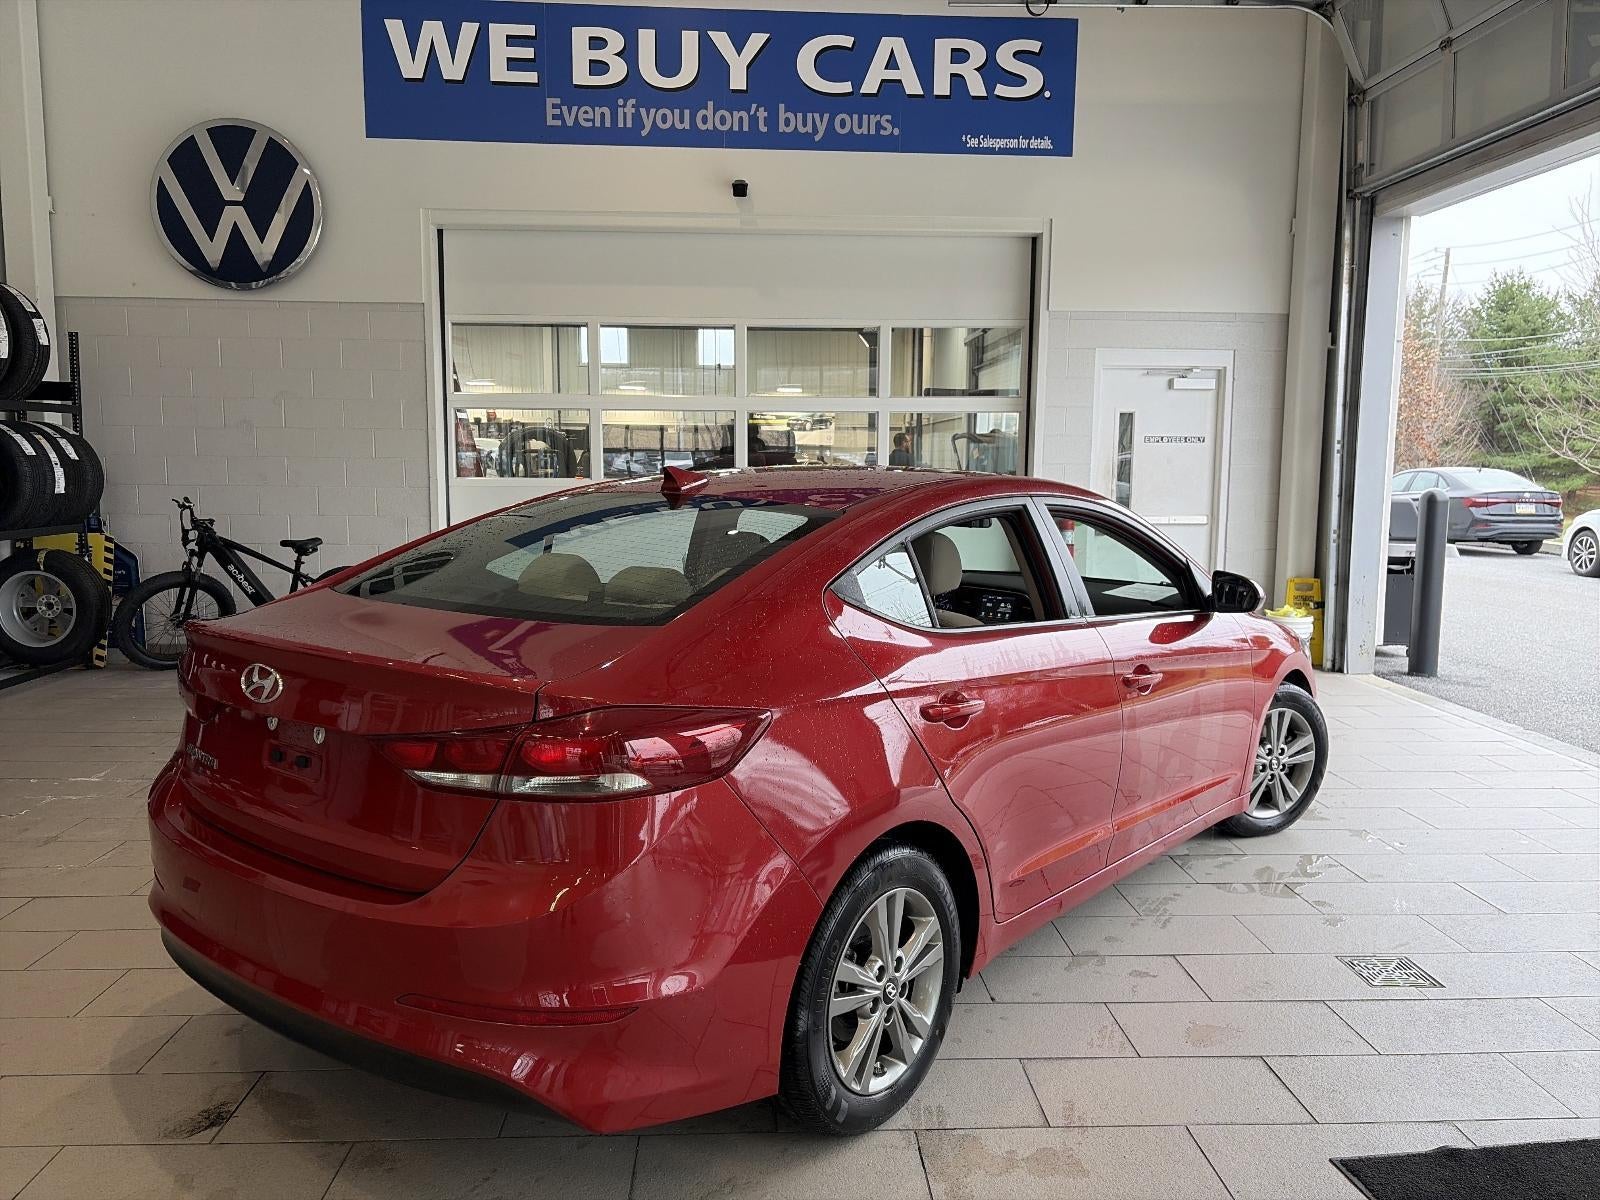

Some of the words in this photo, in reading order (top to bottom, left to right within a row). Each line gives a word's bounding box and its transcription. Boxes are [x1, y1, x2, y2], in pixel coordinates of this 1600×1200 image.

[383, 18, 540, 85] WE
[571, 26, 770, 95] BUY
[796, 34, 1052, 101] CARS.
[546, 97, 611, 128] Even
[617, 98, 636, 128] if
[639, 107, 690, 137] you
[695, 101, 768, 131] don't
[778, 103, 829, 142] buy
[834, 113, 900, 136] ours.
[979, 134, 1018, 151] Salesperson
[1019, 135, 1029, 149] for
[1029, 135, 1054, 150] details.
